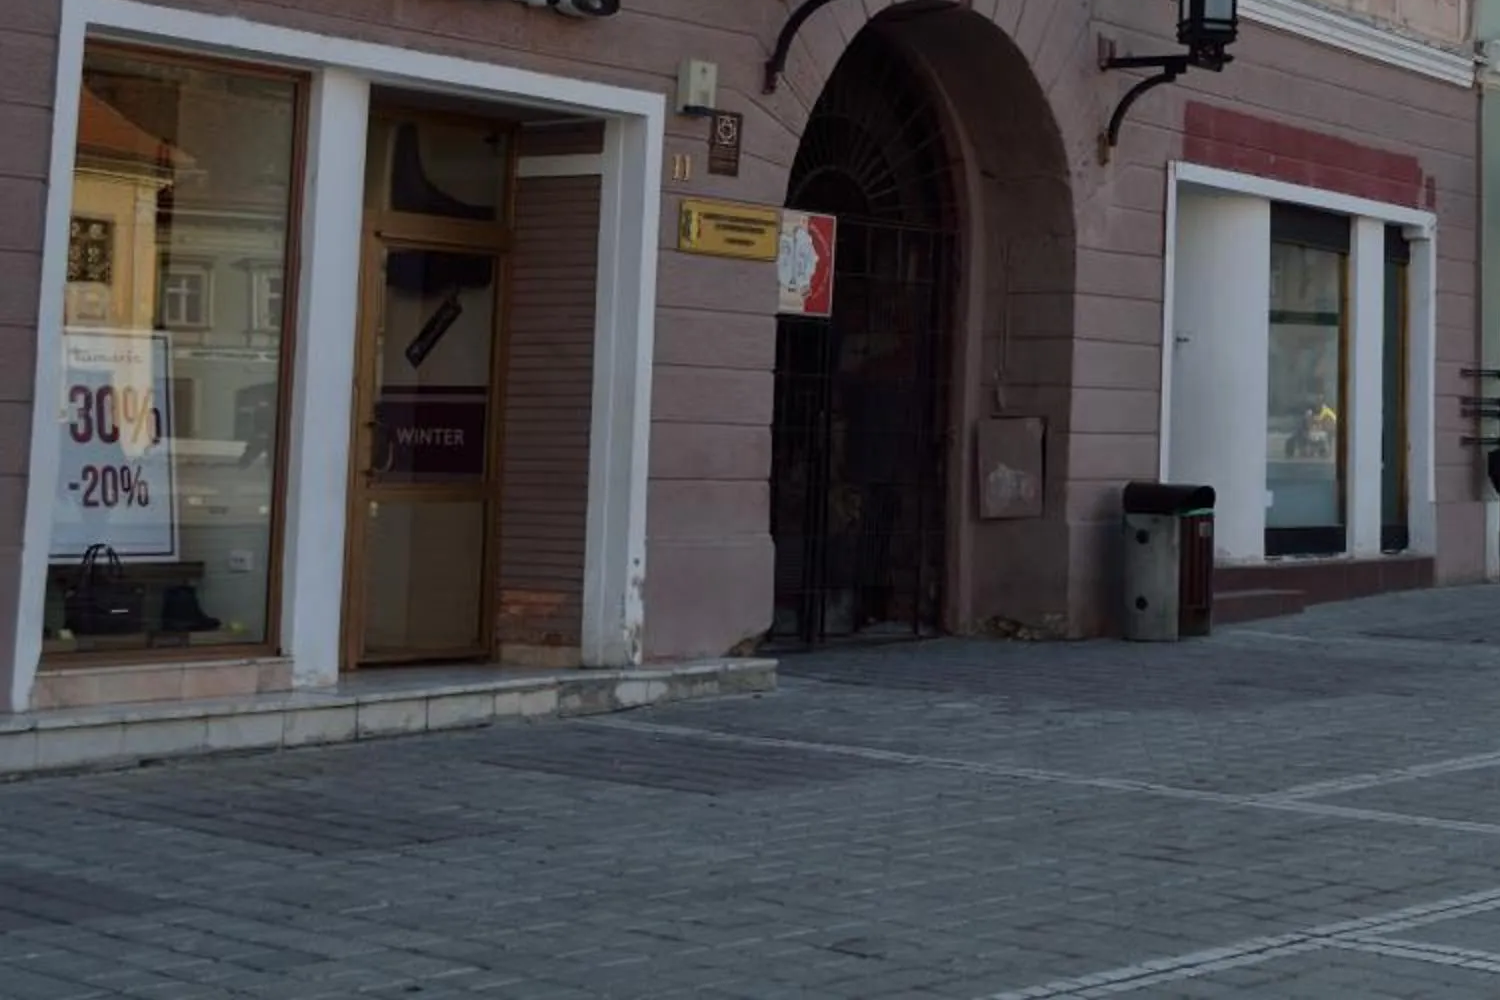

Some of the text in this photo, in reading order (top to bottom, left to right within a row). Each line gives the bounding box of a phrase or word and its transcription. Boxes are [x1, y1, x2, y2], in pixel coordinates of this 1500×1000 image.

[673, 154, 691, 181] 11
[396, 427, 464, 446] WINTER
[69, 465, 149, 508] -20%
